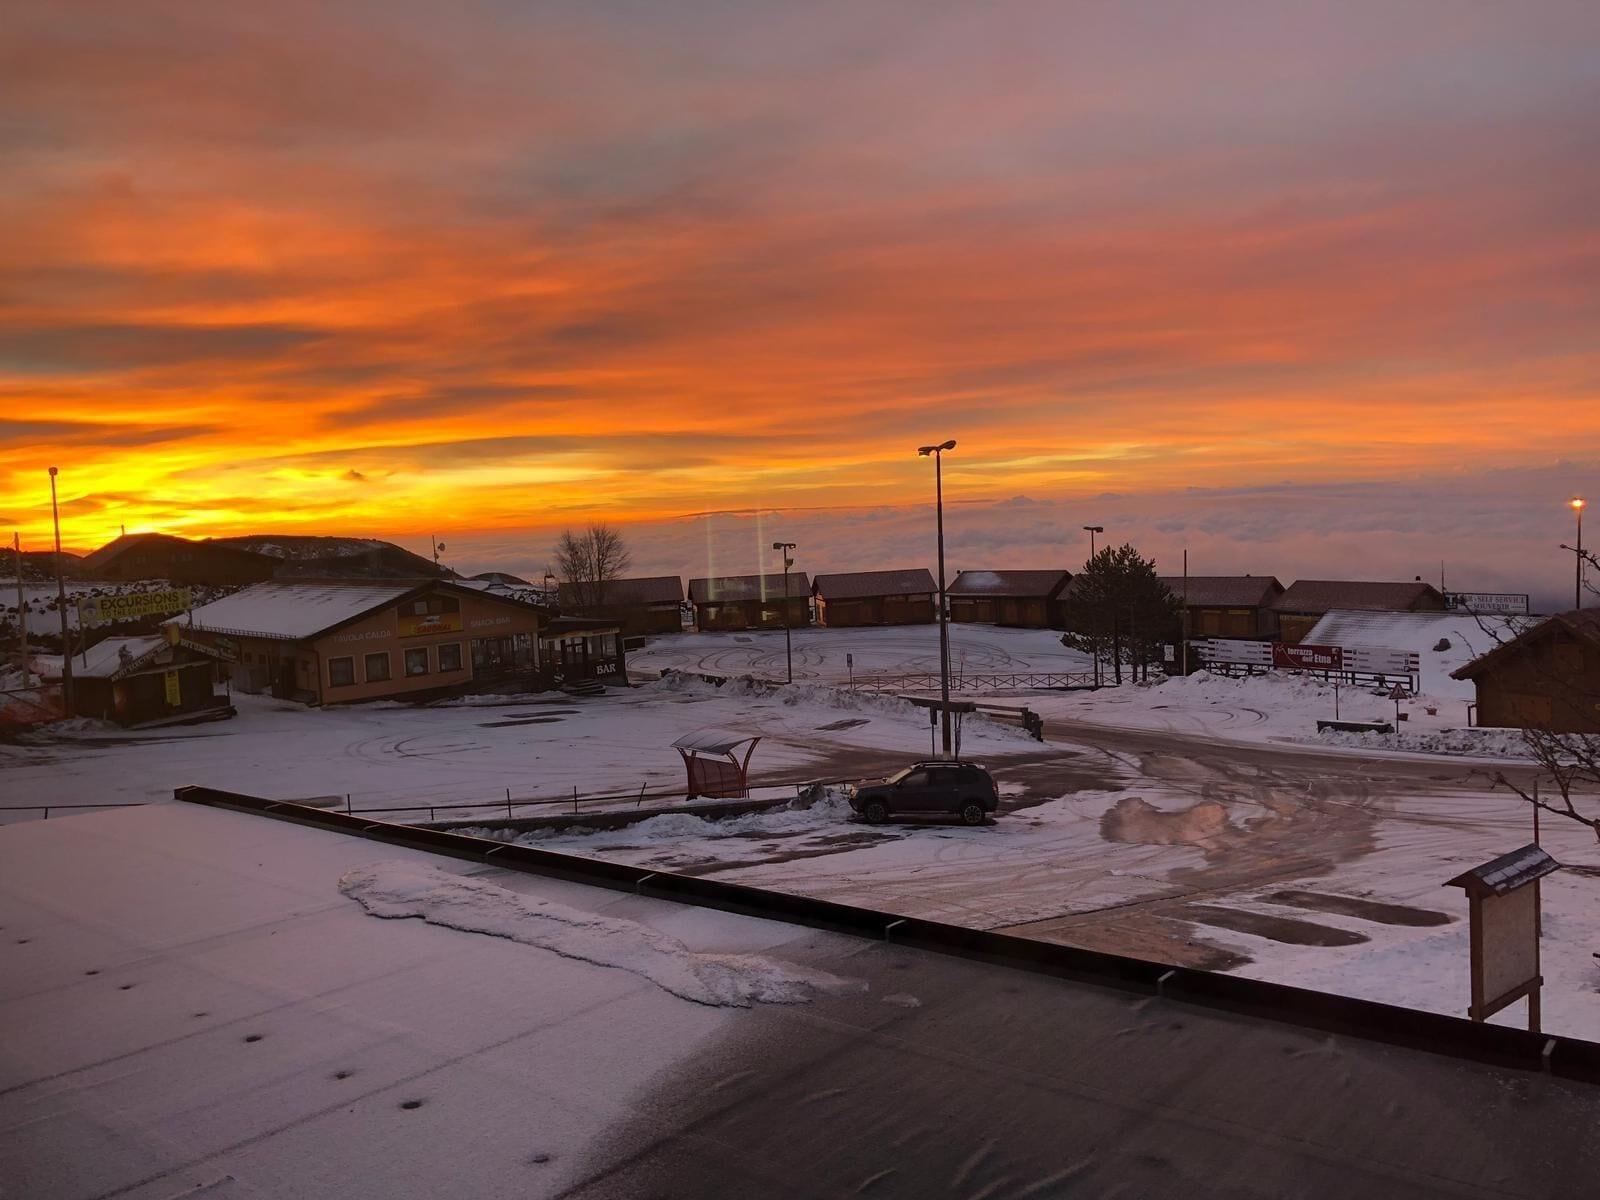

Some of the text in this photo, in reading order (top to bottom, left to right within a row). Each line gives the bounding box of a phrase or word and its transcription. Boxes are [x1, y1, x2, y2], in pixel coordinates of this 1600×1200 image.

[101, 592, 178, 609] EXCURSIONS
[1495, 595, 1525, 604] SERVICE
[102, 609, 111, 617] TO
[113, 607, 126, 616] THE
[128, 604, 154, 614] SUMMIT
[1287, 647, 1313, 656] terrazza
[1314, 654, 1332, 664] Etna
[596, 663, 616, 675] BAR
